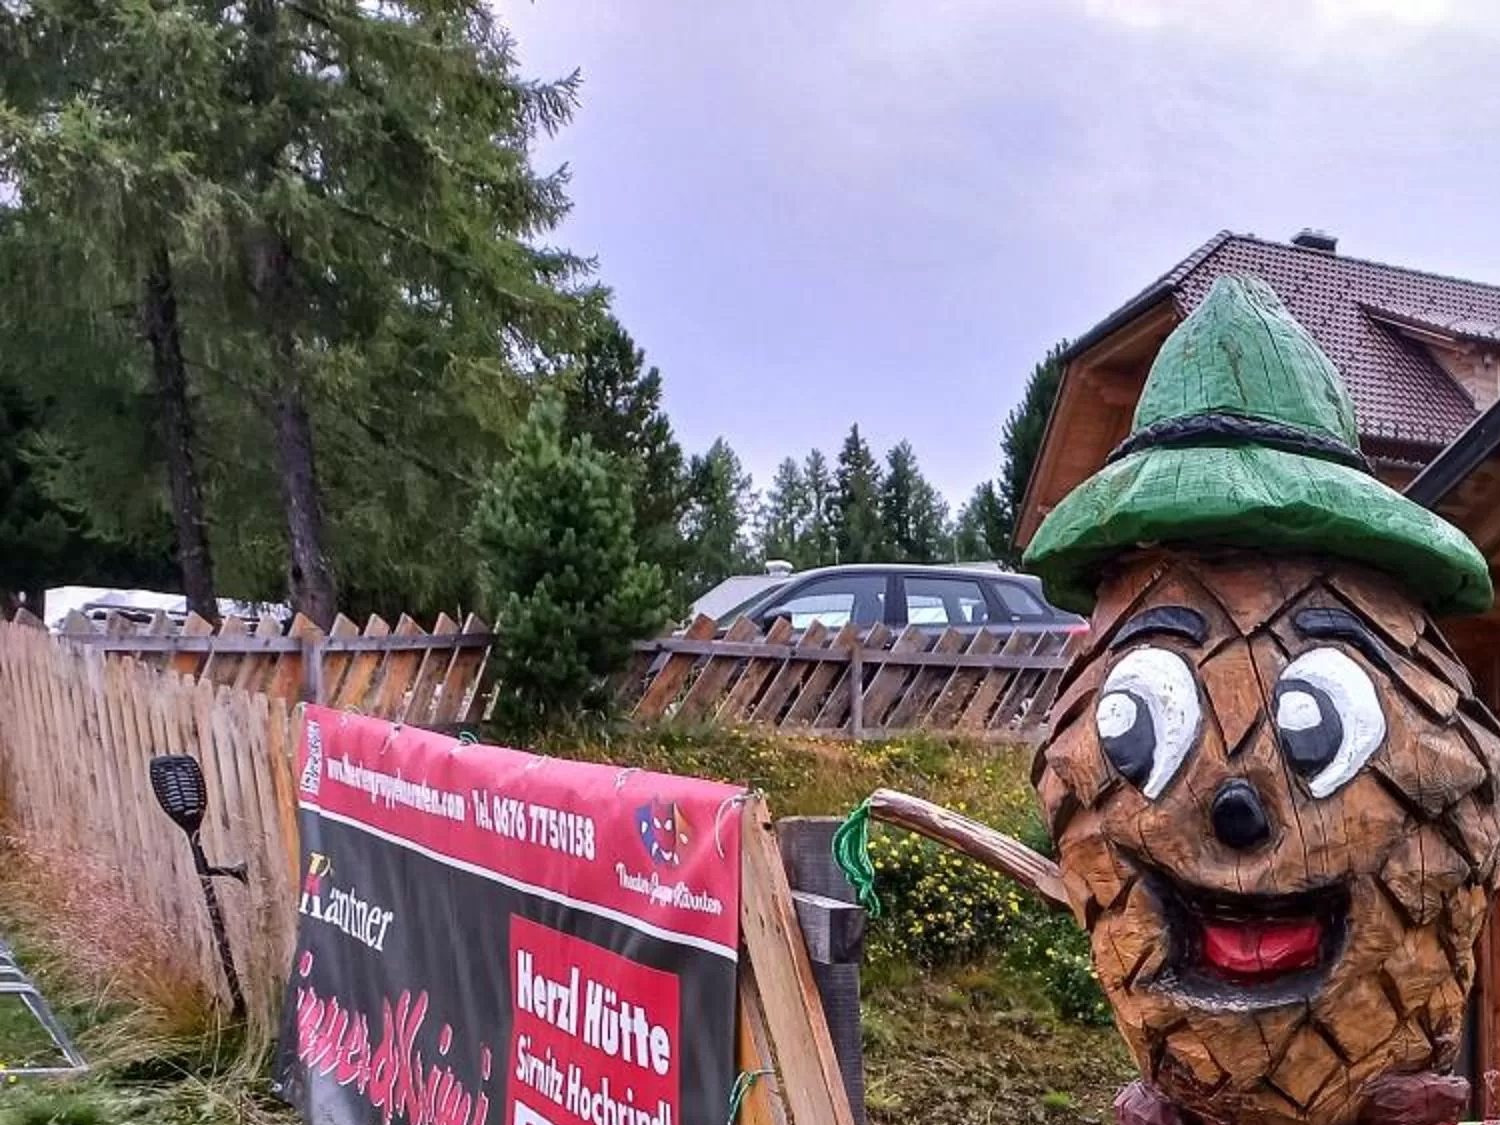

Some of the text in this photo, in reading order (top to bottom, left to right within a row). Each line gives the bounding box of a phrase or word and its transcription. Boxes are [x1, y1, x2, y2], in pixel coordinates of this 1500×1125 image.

[472, 789, 493, 831] Tel.
[493, 795, 527, 841] 0676
[529, 804, 596, 861] 7750158
[517, 949, 671, 1076] Herzl Hütte
[515, 1034, 565, 1105] Sirnitz
